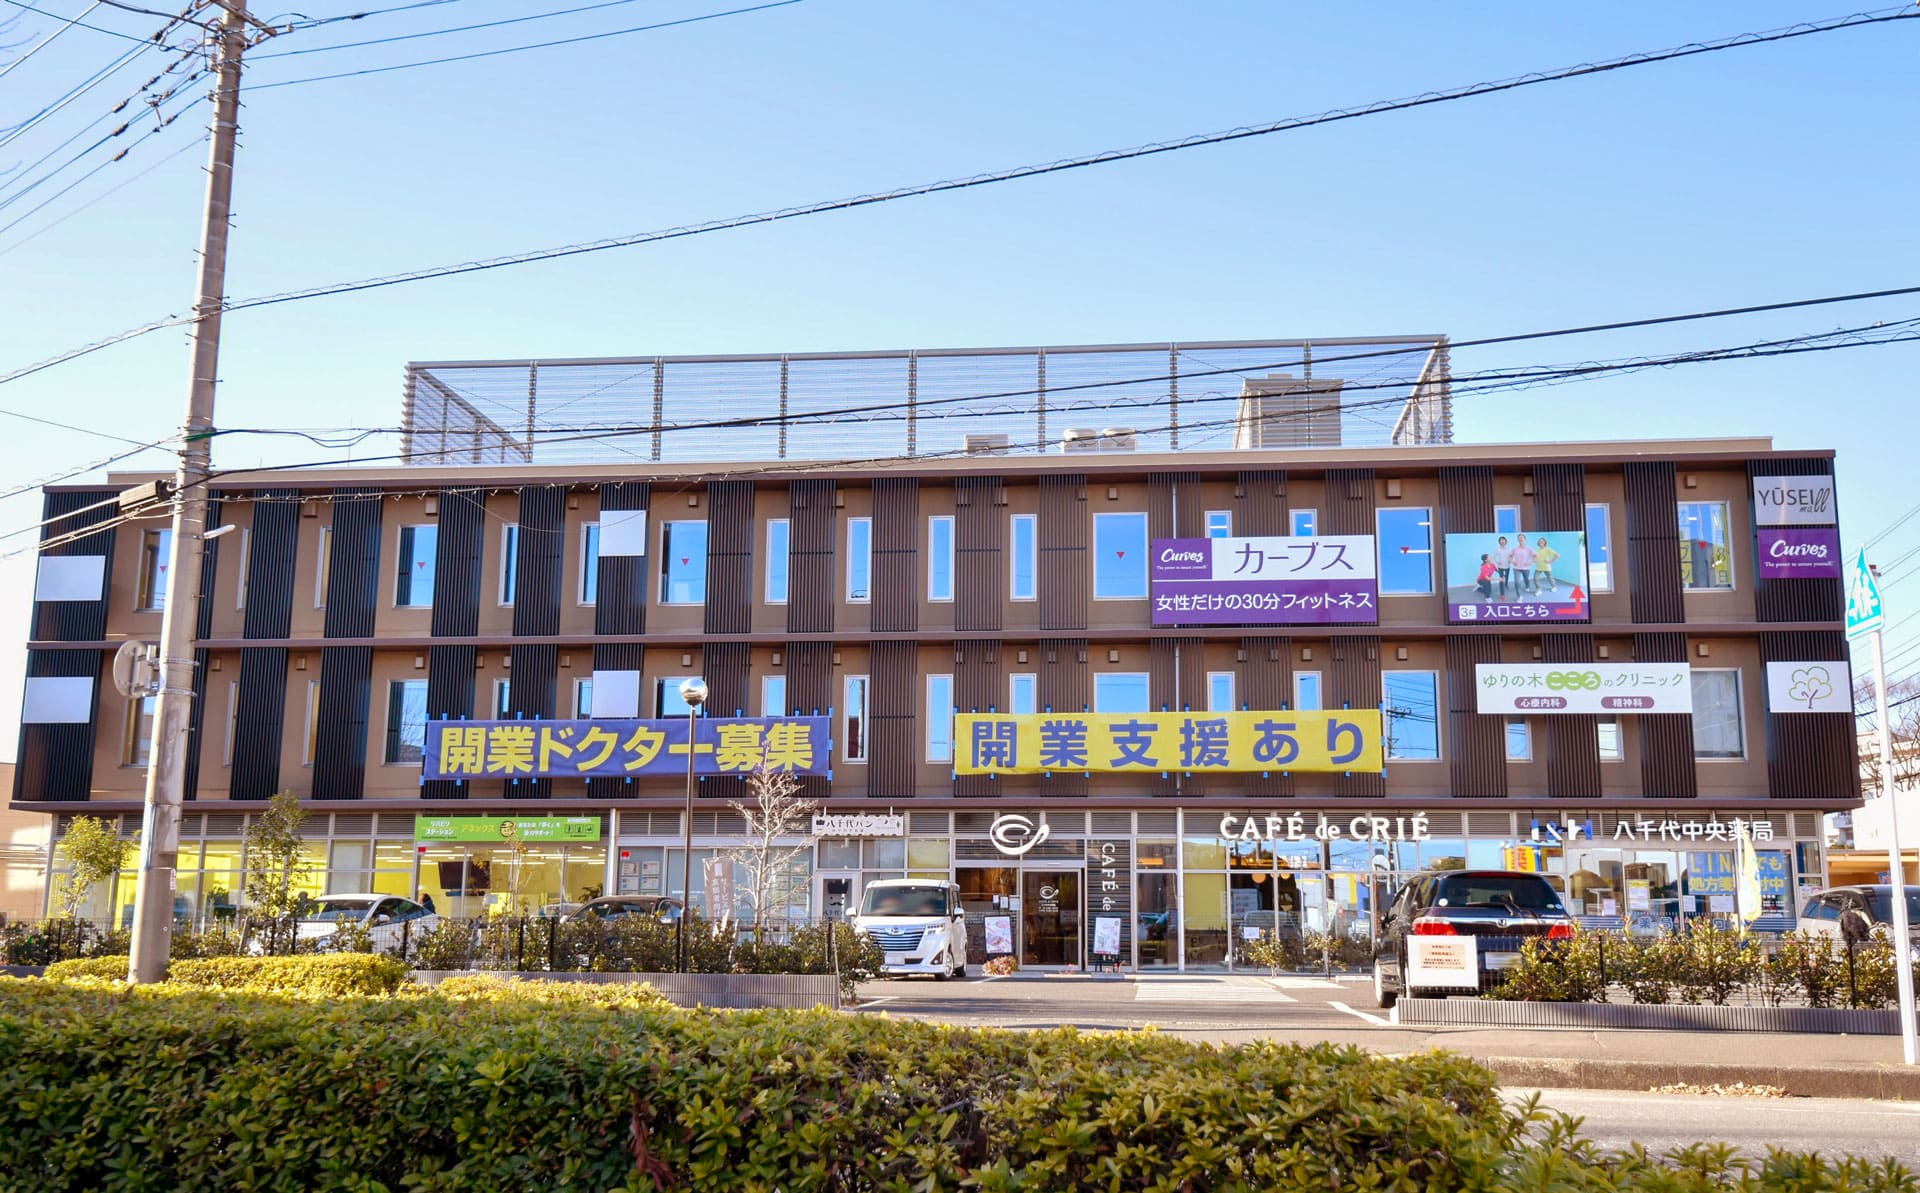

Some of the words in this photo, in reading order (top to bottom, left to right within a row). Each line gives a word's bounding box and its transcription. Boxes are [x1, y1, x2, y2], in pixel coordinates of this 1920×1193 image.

[1160, 548, 1204, 563] Curves
[1769, 539, 1828, 558] Curves
[1233, 542, 1354, 574] カーブス
[1156, 593, 1373, 611] 女性だけの30分フィットネス
[1460, 607, 1476, 618] 3F
[1484, 605, 1550, 618] 入口こちら
[1483, 672, 1684, 690] ゆりの木こころのクリニック
[1520, 696, 1560, 708] 心療内科
[1612, 696, 1643, 708] 精神科
[439, 722, 813, 775] 開業ドクター募集
[971, 717, 1364, 769] 開業支援あり
[1220, 811, 1305, 840] CAFÉ
[1315, 816, 1341, 840] de
[1349, 811, 1431, 840] CRIÉ
[1613, 819, 1774, 842] 八千代中央薬局
[1102, 843, 1120, 892] CAFÉ
[1102, 896, 1116, 911] de
